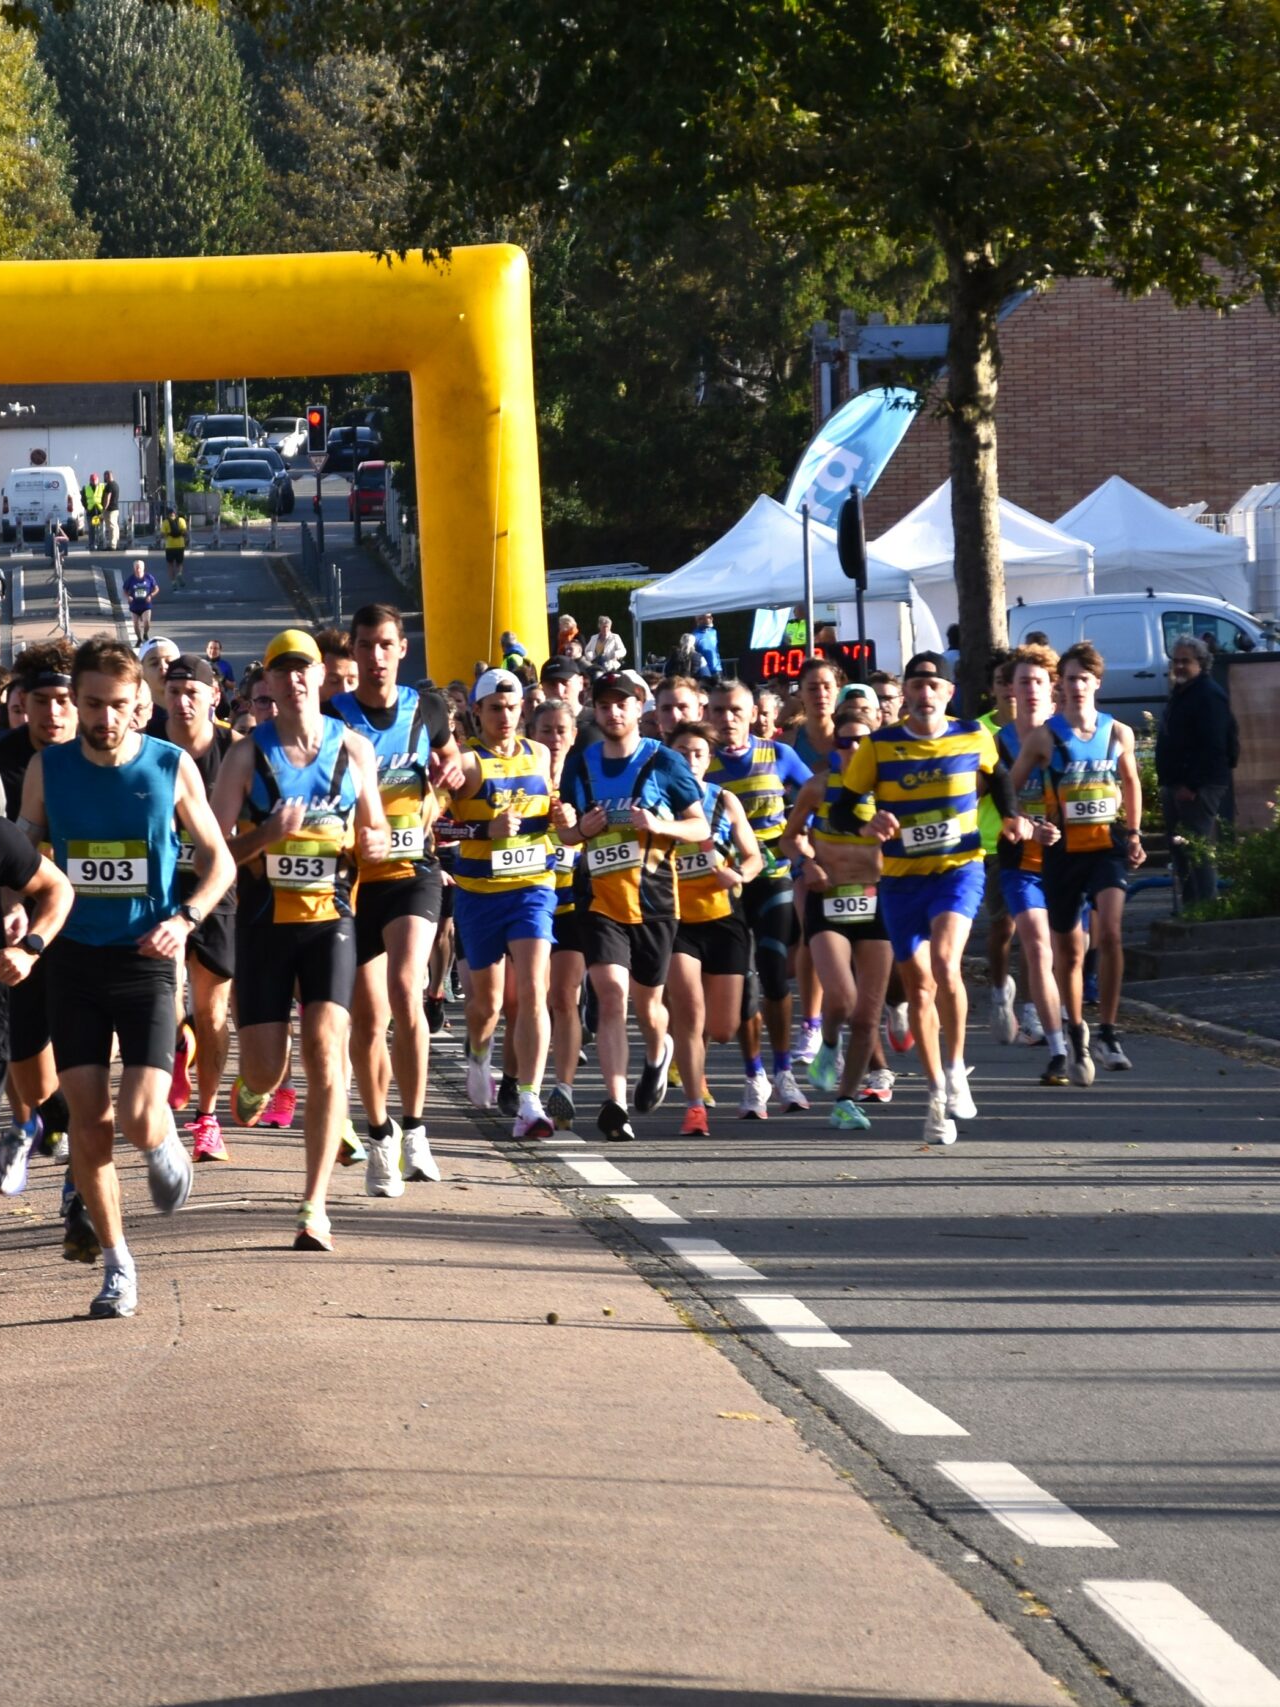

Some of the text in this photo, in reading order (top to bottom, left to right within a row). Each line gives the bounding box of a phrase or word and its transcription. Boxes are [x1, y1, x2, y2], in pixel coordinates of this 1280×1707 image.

[1075, 801, 1107, 816] 968
[912, 822, 950, 842] 892
[502, 848, 535, 866] 907
[594, 844, 630, 865] 956
[81, 860, 134, 882] 903
[277, 857, 325, 878] 953
[833, 897, 868, 913] 905
